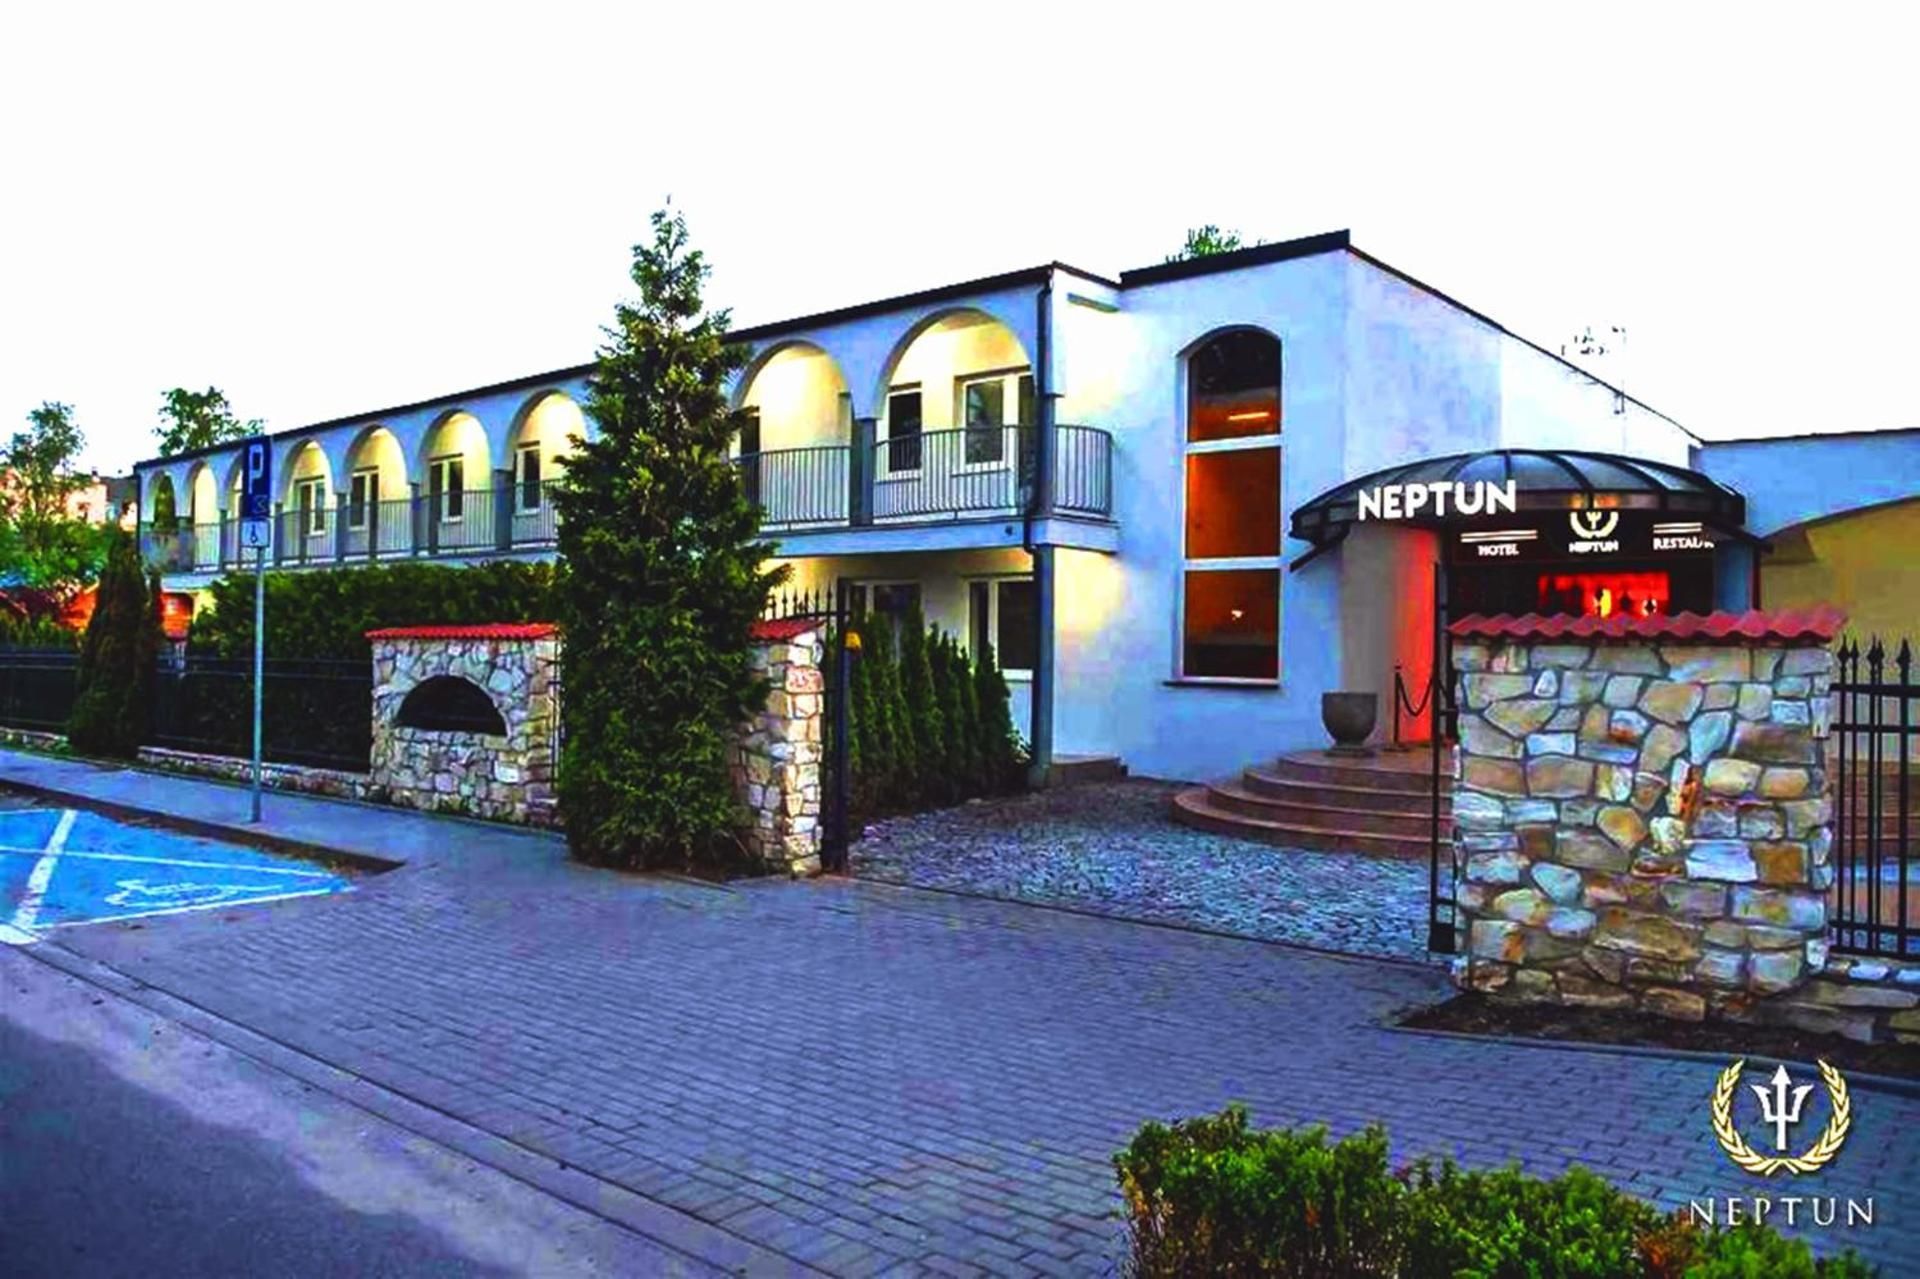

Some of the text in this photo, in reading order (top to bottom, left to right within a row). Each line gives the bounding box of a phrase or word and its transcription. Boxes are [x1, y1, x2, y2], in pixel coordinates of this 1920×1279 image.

[1358, 480, 1516, 521] NEPTUN
[1478, 543, 1519, 556] HOTEL
[1568, 540, 1619, 553] NEPTUN
